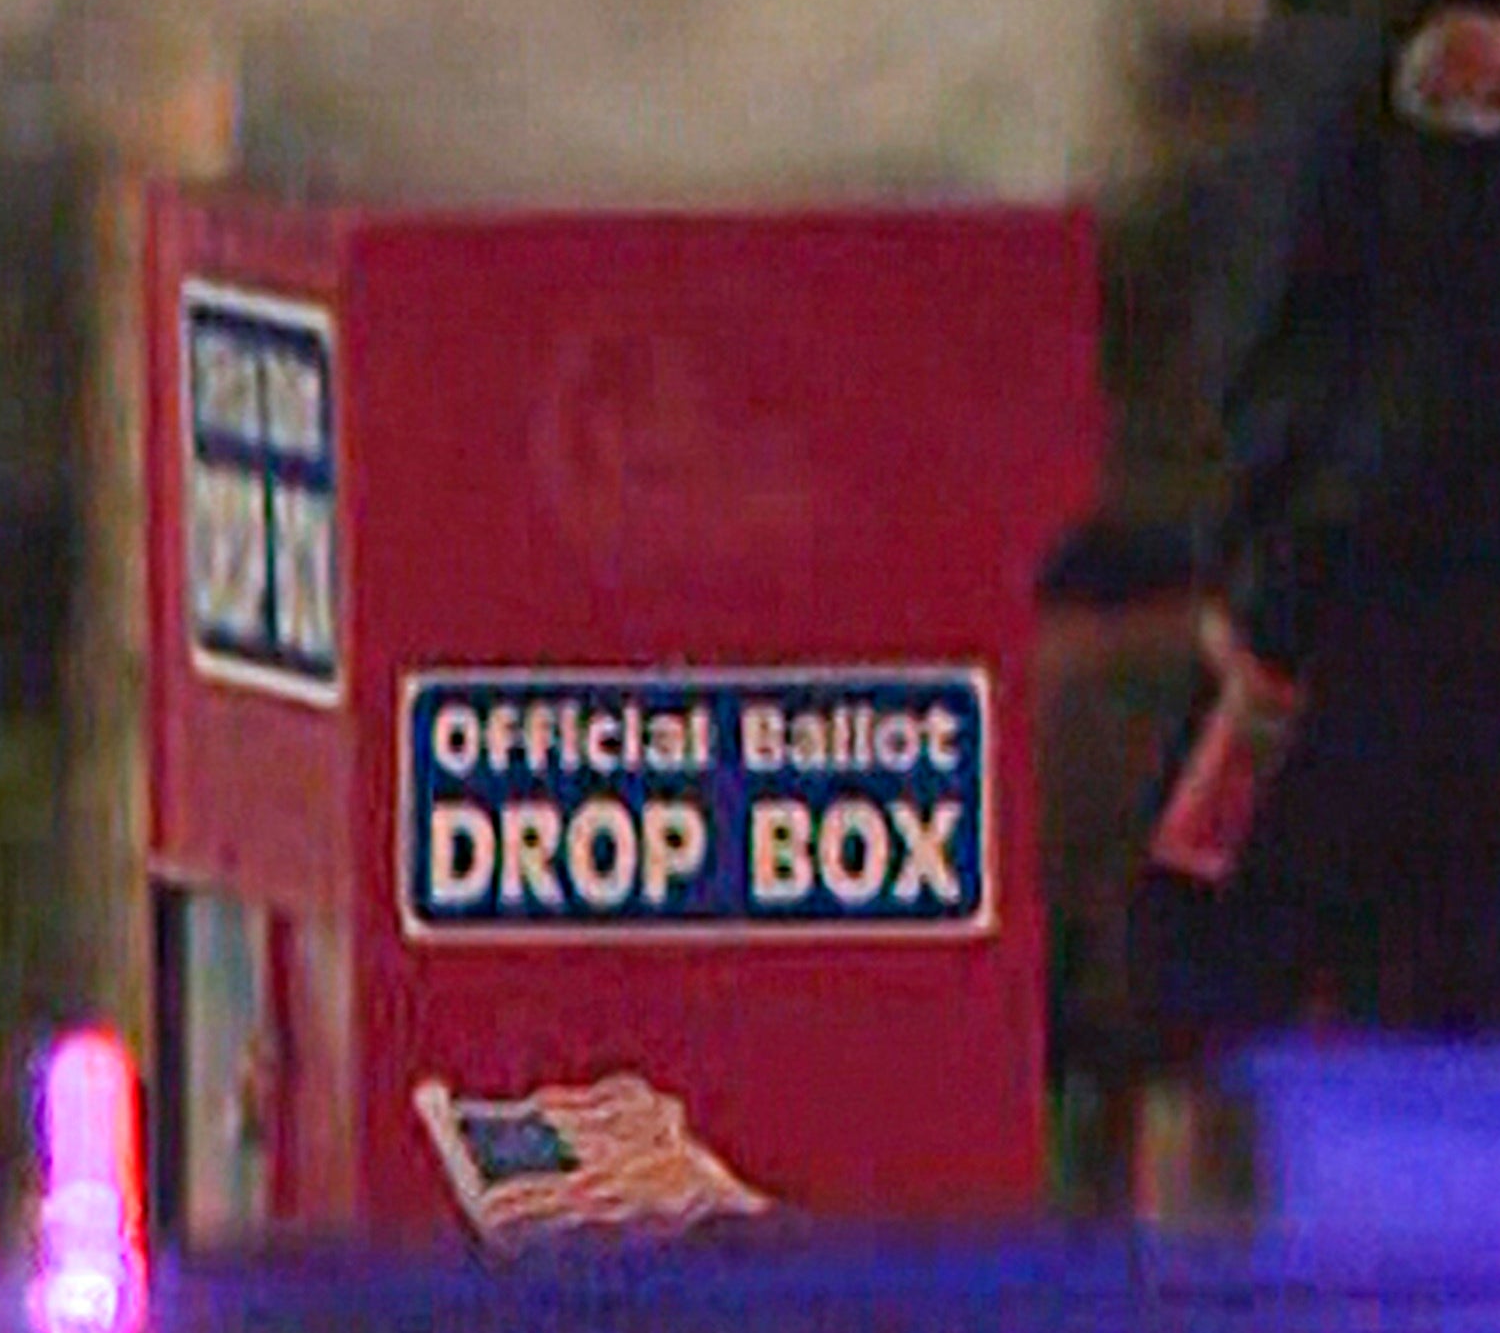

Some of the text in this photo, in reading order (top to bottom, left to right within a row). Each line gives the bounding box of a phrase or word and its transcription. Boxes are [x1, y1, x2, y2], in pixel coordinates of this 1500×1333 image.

[432, 703, 959, 774] Official Ballot
[429, 800, 962, 907] DROP BOX
